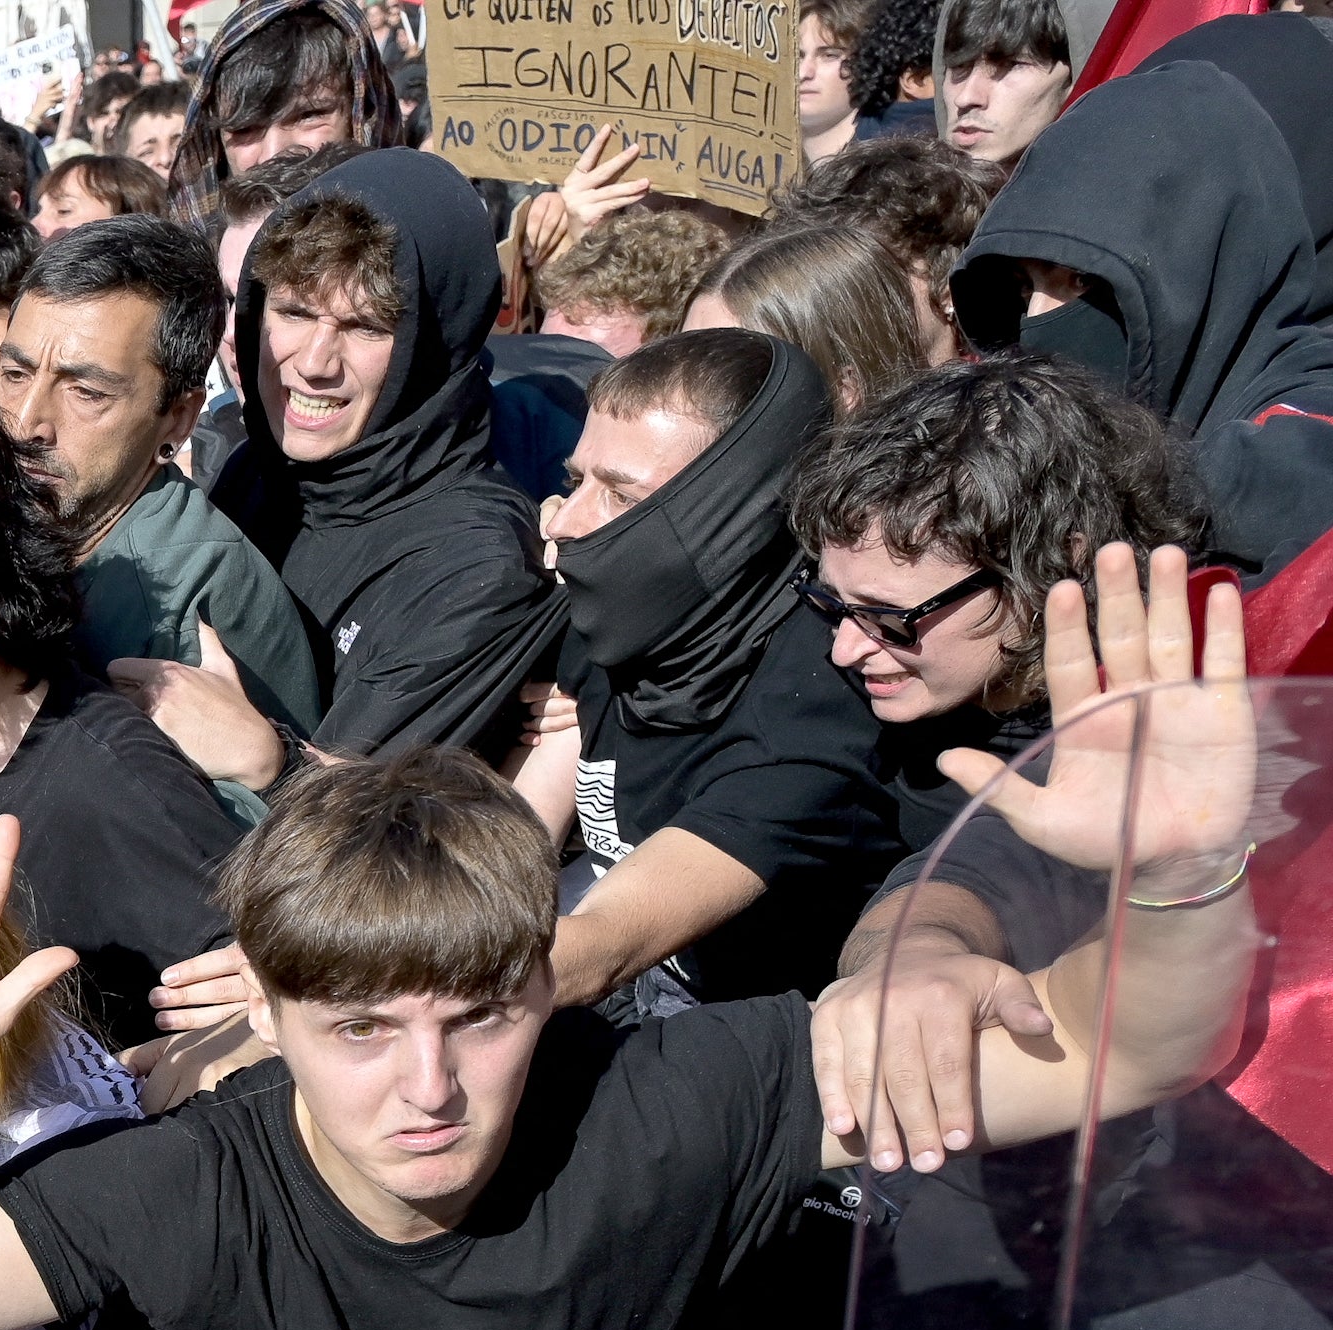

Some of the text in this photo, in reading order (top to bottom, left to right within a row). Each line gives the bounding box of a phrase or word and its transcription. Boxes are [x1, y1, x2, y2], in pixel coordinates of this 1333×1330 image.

[592, 1, 614, 27] OS
[454, 41, 778, 139] IGNORANTE!!
[441, 116, 475, 151] AO
[499, 118, 596, 154] ODIO
[802, 1197, 872, 1227] gio Tacchi
